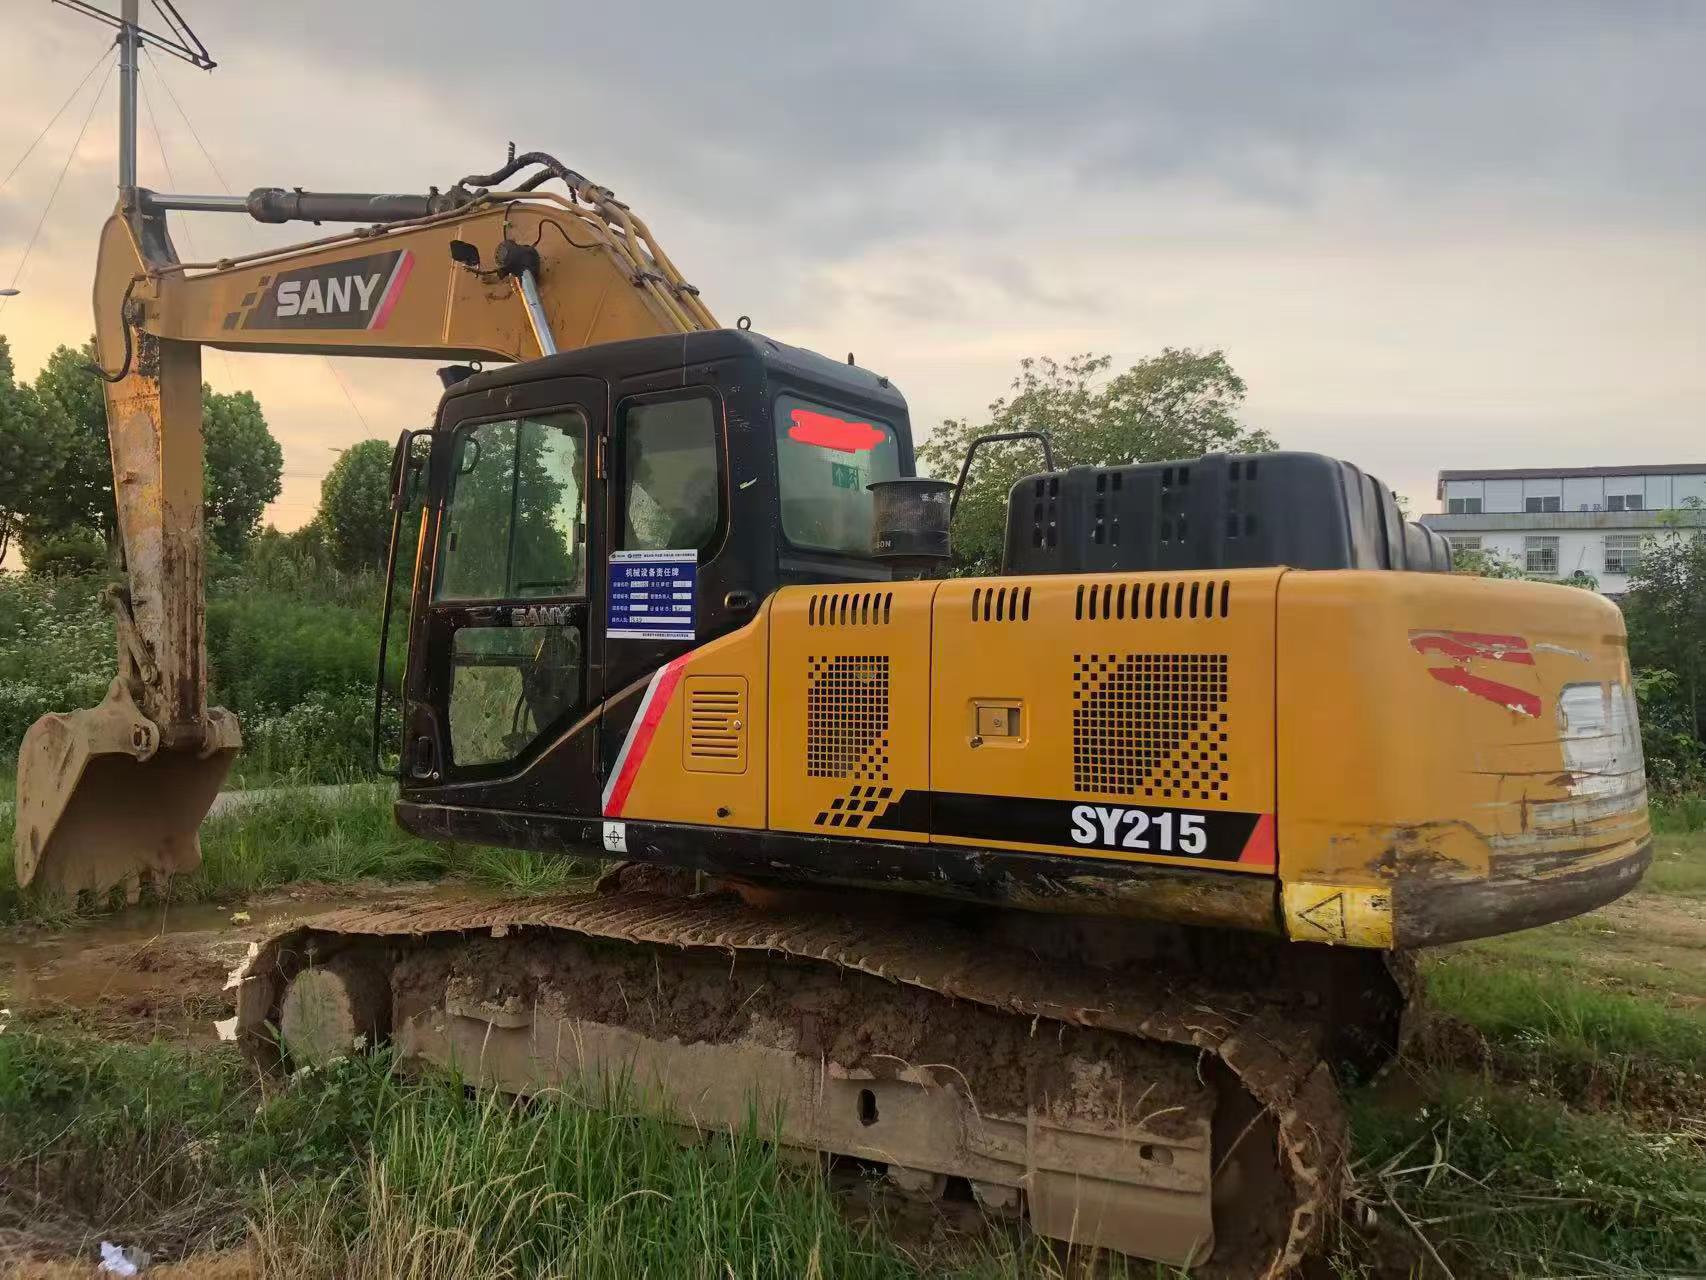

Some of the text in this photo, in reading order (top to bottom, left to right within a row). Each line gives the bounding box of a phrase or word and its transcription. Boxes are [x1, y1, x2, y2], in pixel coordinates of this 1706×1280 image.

[277, 273, 381, 317] SANY
[625, 567, 680, 577] 机械设备责任牌
[511, 604, 572, 627] SANY
[1071, 805, 1207, 854] SY215
